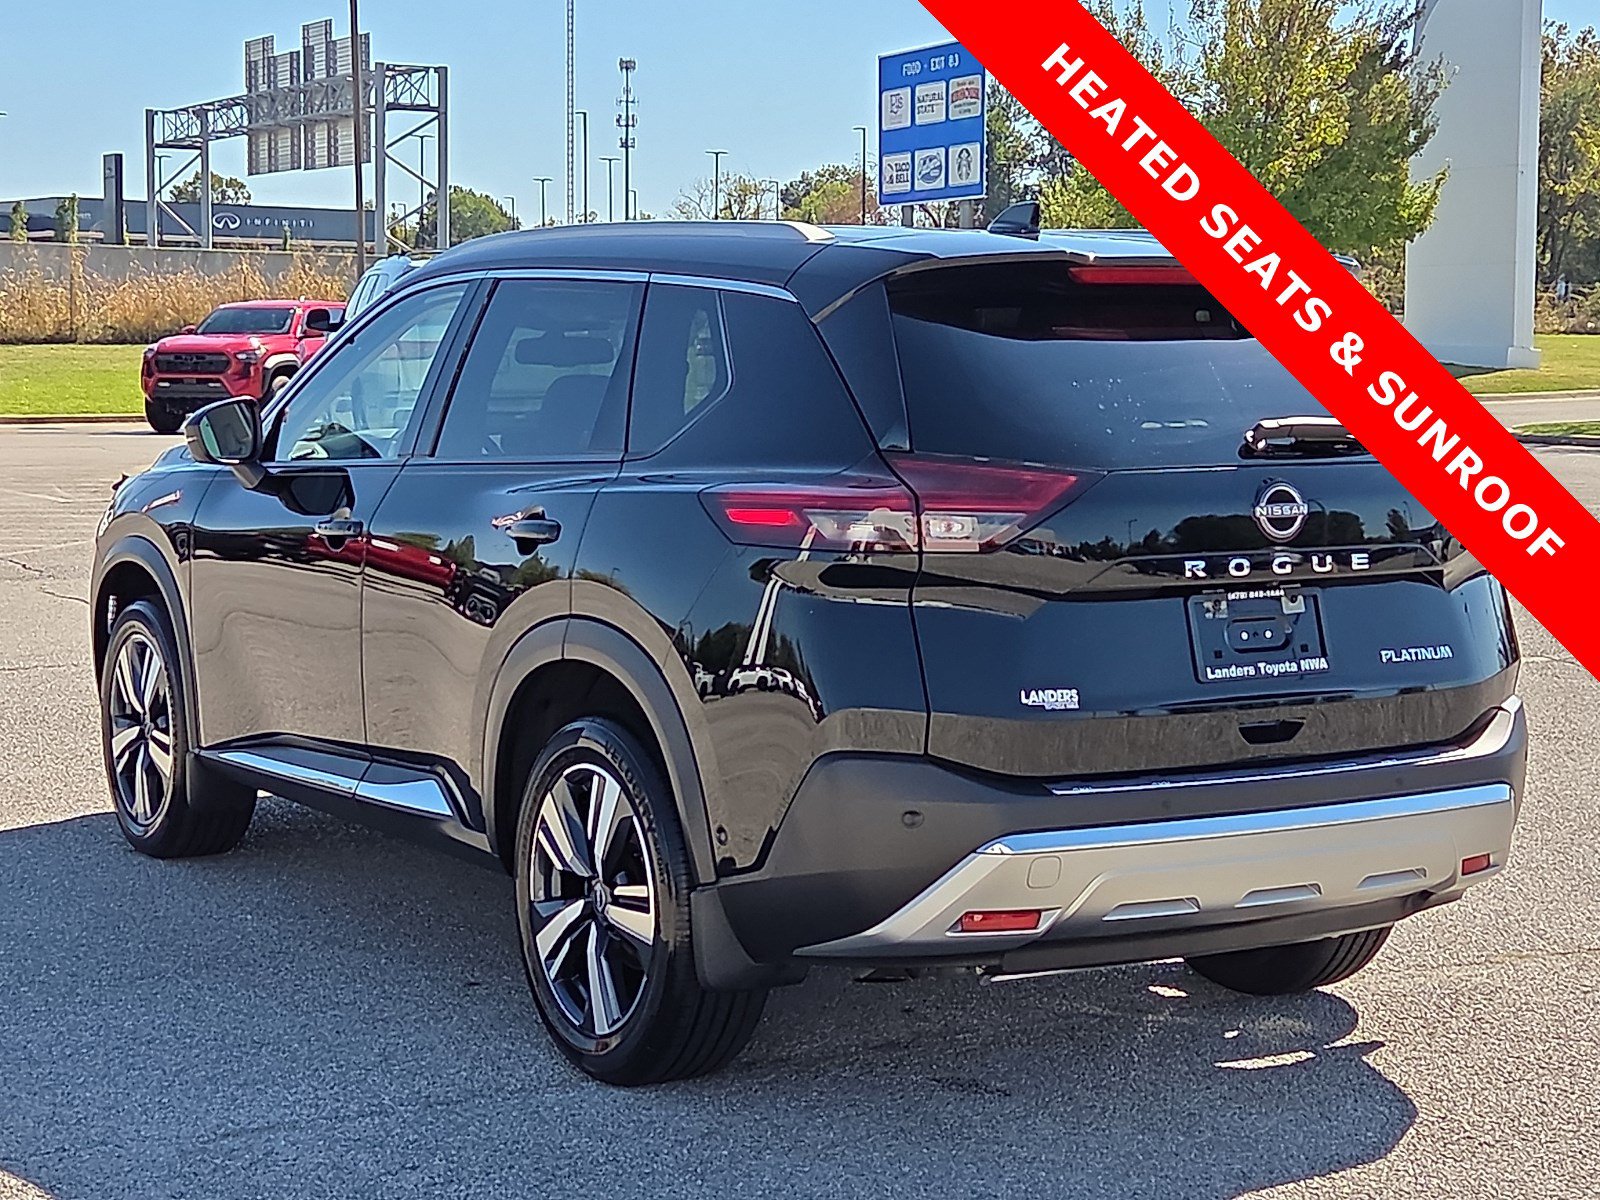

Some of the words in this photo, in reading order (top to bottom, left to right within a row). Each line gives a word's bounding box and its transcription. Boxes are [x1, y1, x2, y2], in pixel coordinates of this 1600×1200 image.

[930, 56, 946, 71] EXIT
[917, 92, 944, 103] NATURAL
[917, 103, 935, 114] STATE
[895, 162, 910, 173] TACO
[895, 173, 910, 184] BELL
[246, 217, 314, 228] INFINITI
[1256, 503, 1308, 517] NISSAN
[1184, 553, 1370, 578] ROGUE
[1380, 645, 1453, 662] PLATINUM
[1206, 664, 1256, 679] Landers
[1257, 661, 1298, 676] Toyota
[1300, 657, 1329, 671] NWA
[1020, 688, 1079, 704] LANDERS
